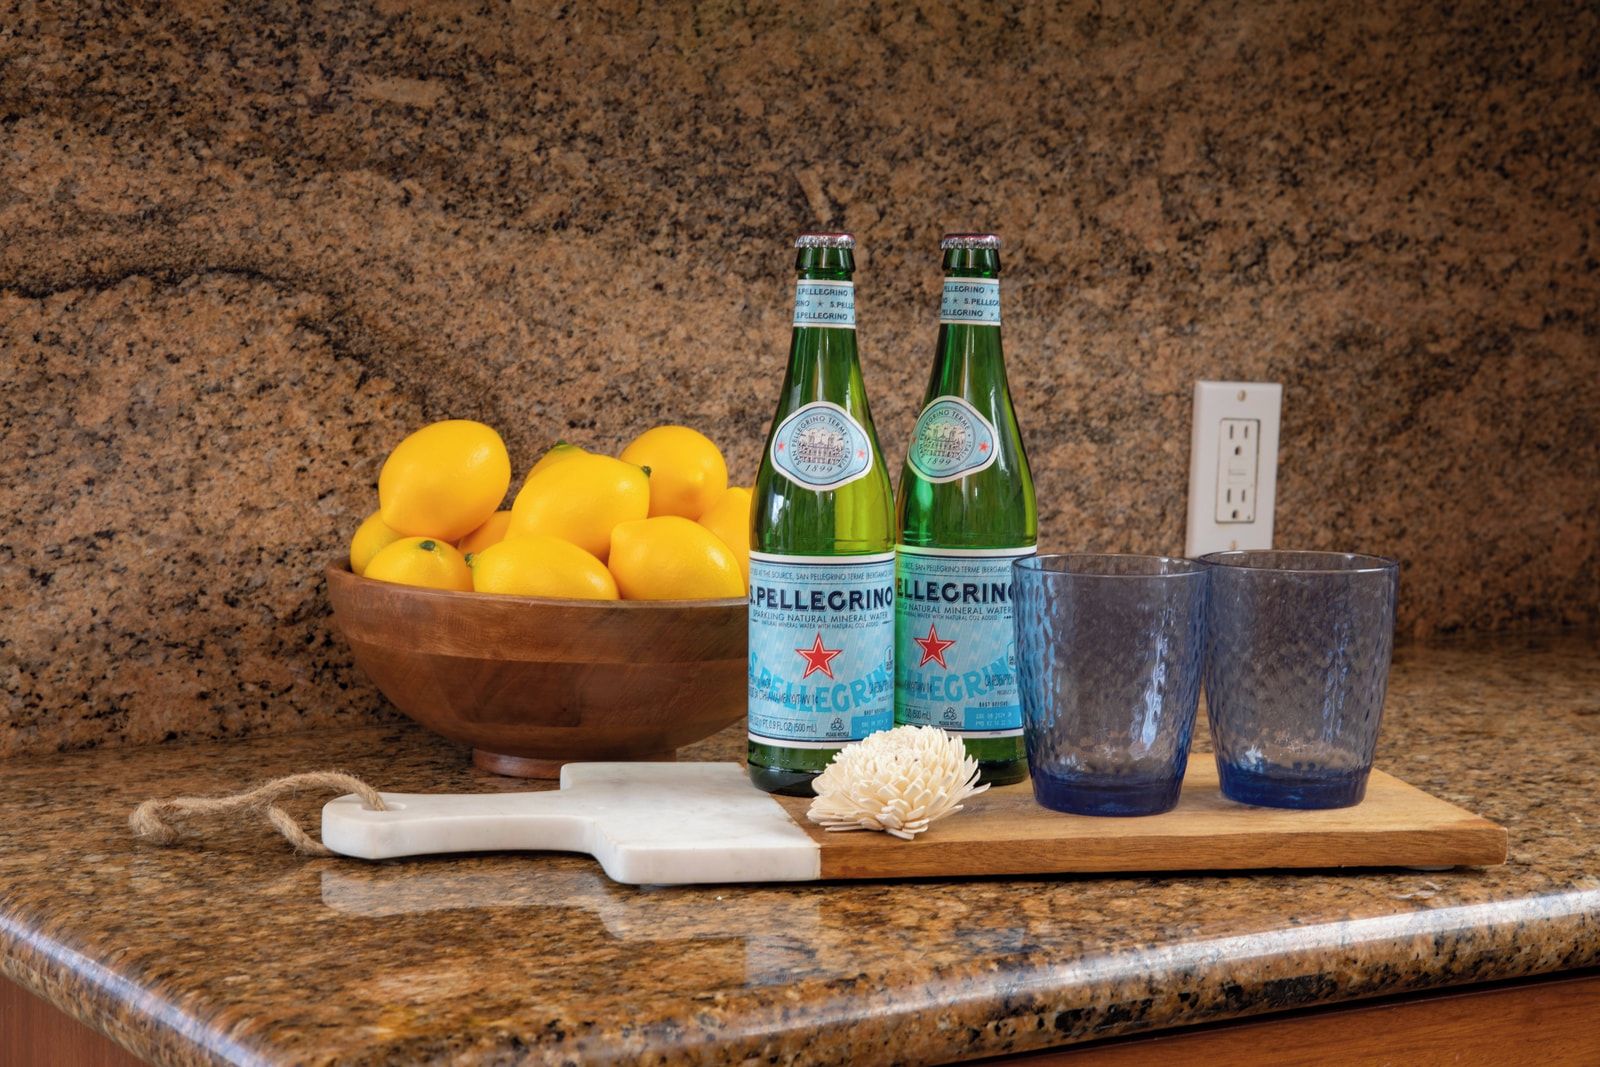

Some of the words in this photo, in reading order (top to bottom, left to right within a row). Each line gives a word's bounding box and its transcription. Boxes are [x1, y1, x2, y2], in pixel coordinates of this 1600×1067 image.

[952, 410, 970, 430] TERME
[791, 415, 826, 448] PELLEGRINO
[827, 417, 848, 436] TERME
[927, 457, 952, 465] 1899
[805, 464, 833, 473] 1899
[796, 572, 810, 580] SAN
[810, 573, 847, 581] PELLEGRINO
[896, 577, 1012, 604] ELLEGRIN
[908, 603, 941, 614] NATURAL
[944, 605, 983, 615] MINERAL
[788, 613, 827, 623] NATURAL
[830, 613, 867, 623] MINERAL
[869, 611, 888, 620] WATER
